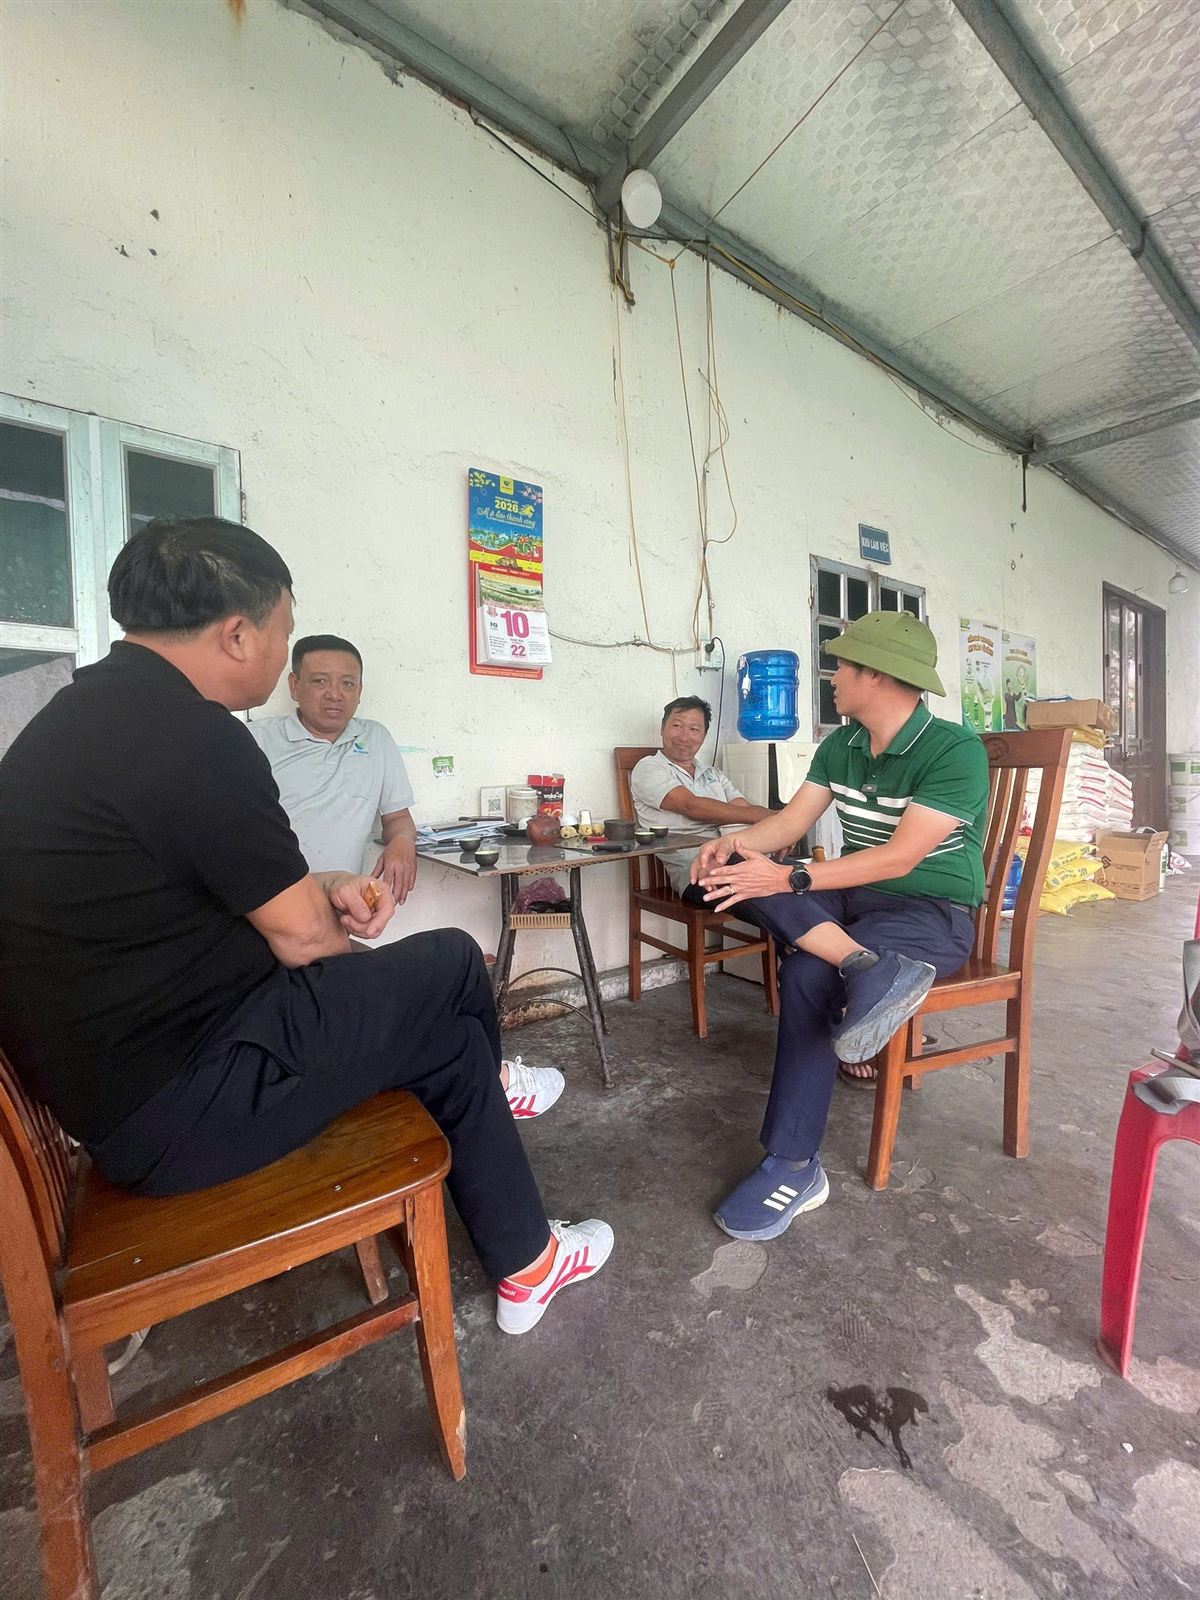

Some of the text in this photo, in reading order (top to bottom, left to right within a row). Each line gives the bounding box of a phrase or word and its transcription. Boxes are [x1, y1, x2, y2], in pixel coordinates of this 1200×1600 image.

[494, 499, 519, 513] 2026
[500, 610, 530, 638] 10
[511, 644, 526, 657] 22
